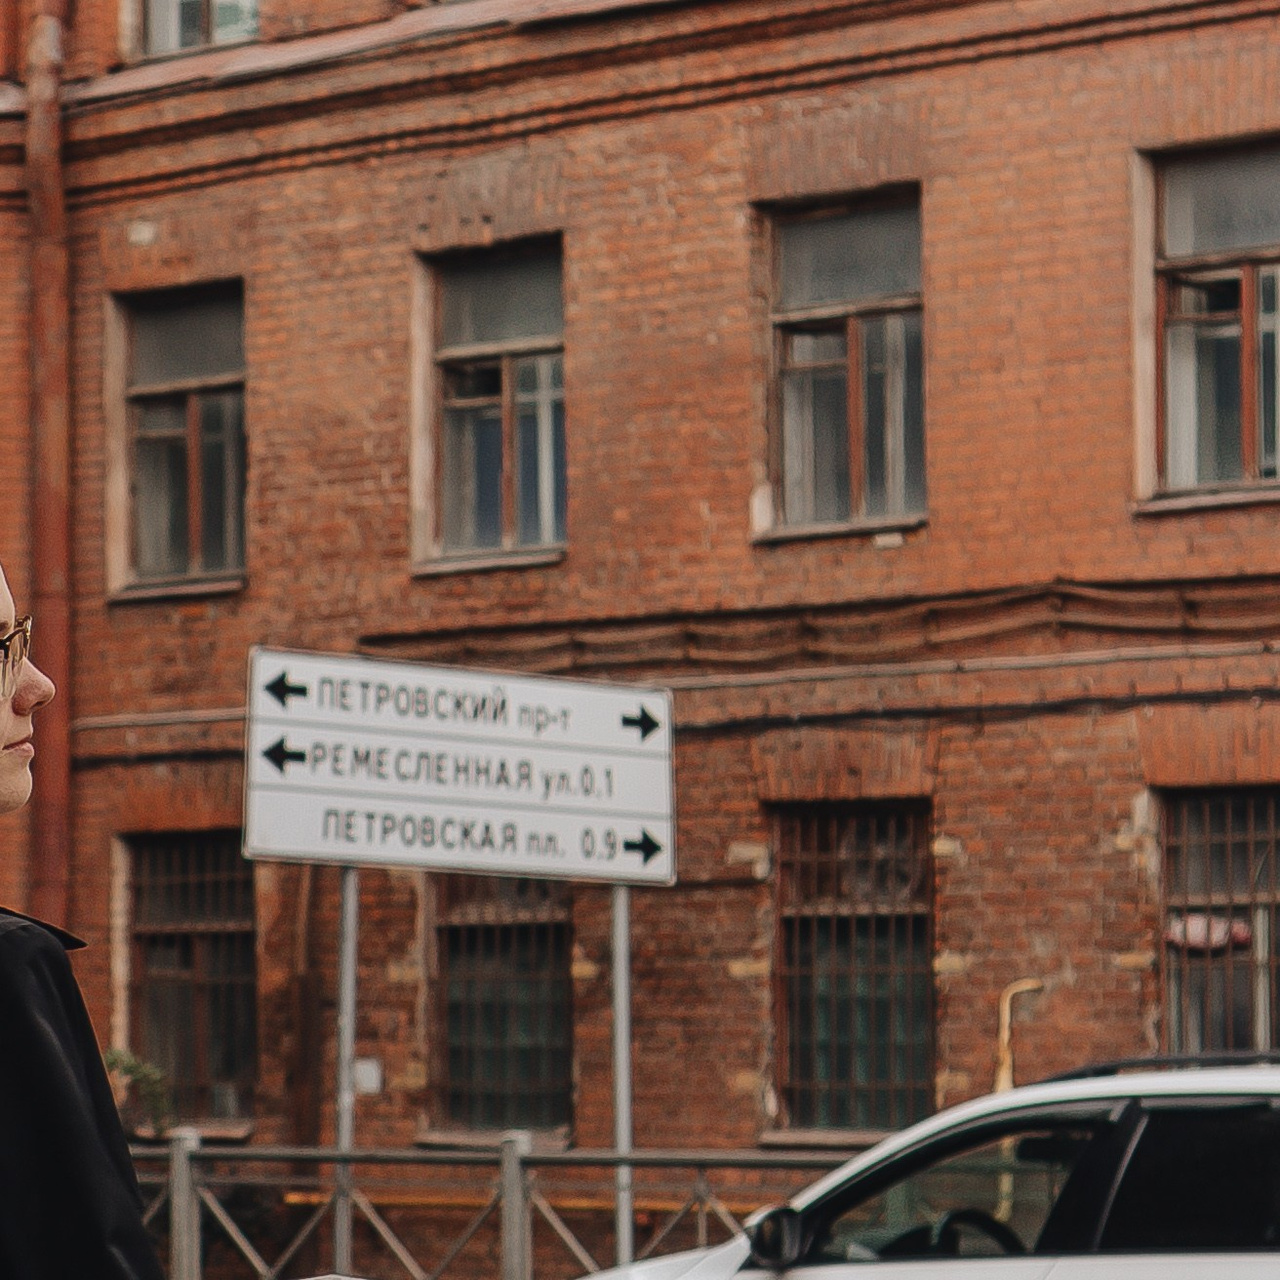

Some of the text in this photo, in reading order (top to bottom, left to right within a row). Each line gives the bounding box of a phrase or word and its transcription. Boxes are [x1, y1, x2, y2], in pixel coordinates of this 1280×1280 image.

[318, 676, 571, 736] ПЕТРОВСКИЙ пр-т
[310, 741, 533, 792] РЕМЕСЛЕННАЯ
[322, 808, 518, 854] ПЕТРОВСКАЯ
[582, 827, 617, 860] 0.9
